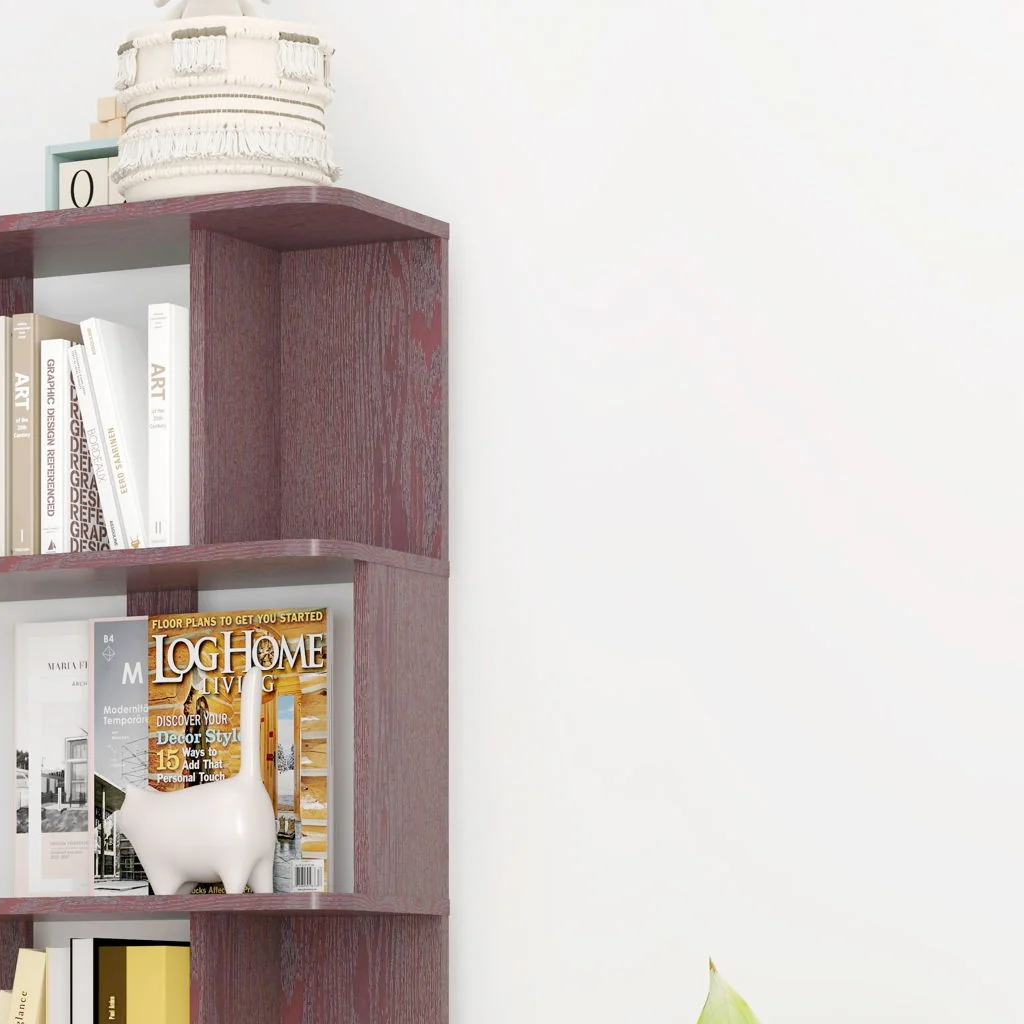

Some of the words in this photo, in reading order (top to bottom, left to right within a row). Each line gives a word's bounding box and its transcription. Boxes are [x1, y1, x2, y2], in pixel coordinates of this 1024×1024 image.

[15, 372, 30, 410] ART
[47, 359, 55, 405] GRAPHIC
[151, 363, 165, 400] ART
[47, 408, 55, 446] DESIGN
[107, 427, 123, 471] SAARINEN
[47, 449, 55, 517] REFERENCED
[117, 472, 128, 495] EERO
[152, 618, 182, 629] FLOOR
[186, 616, 216, 627] PLANS
[220, 616, 232, 626] TO
[235, 615, 253, 625] GET
[257, 613, 276, 624] YOU
[280, 611, 323, 623] STARTED
[103, 634, 114, 643] B4
[48, 661, 76, 670] MARIA
[121, 661, 144, 684] M
[201, 675, 275, 695] LIVIG
[156, 714, 201, 727] DISCOVER
[203, 711, 228, 725] YOUR
[156, 730, 202, 745] Decor
[156, 749, 180, 770] 15
[182, 747, 205, 758] Ways
[208, 747, 217, 756] to
[182, 760, 199, 770] Add
[203, 759, 223, 769] That
[157, 772, 196, 783] Personal
[199, 771, 225, 781] Touch
